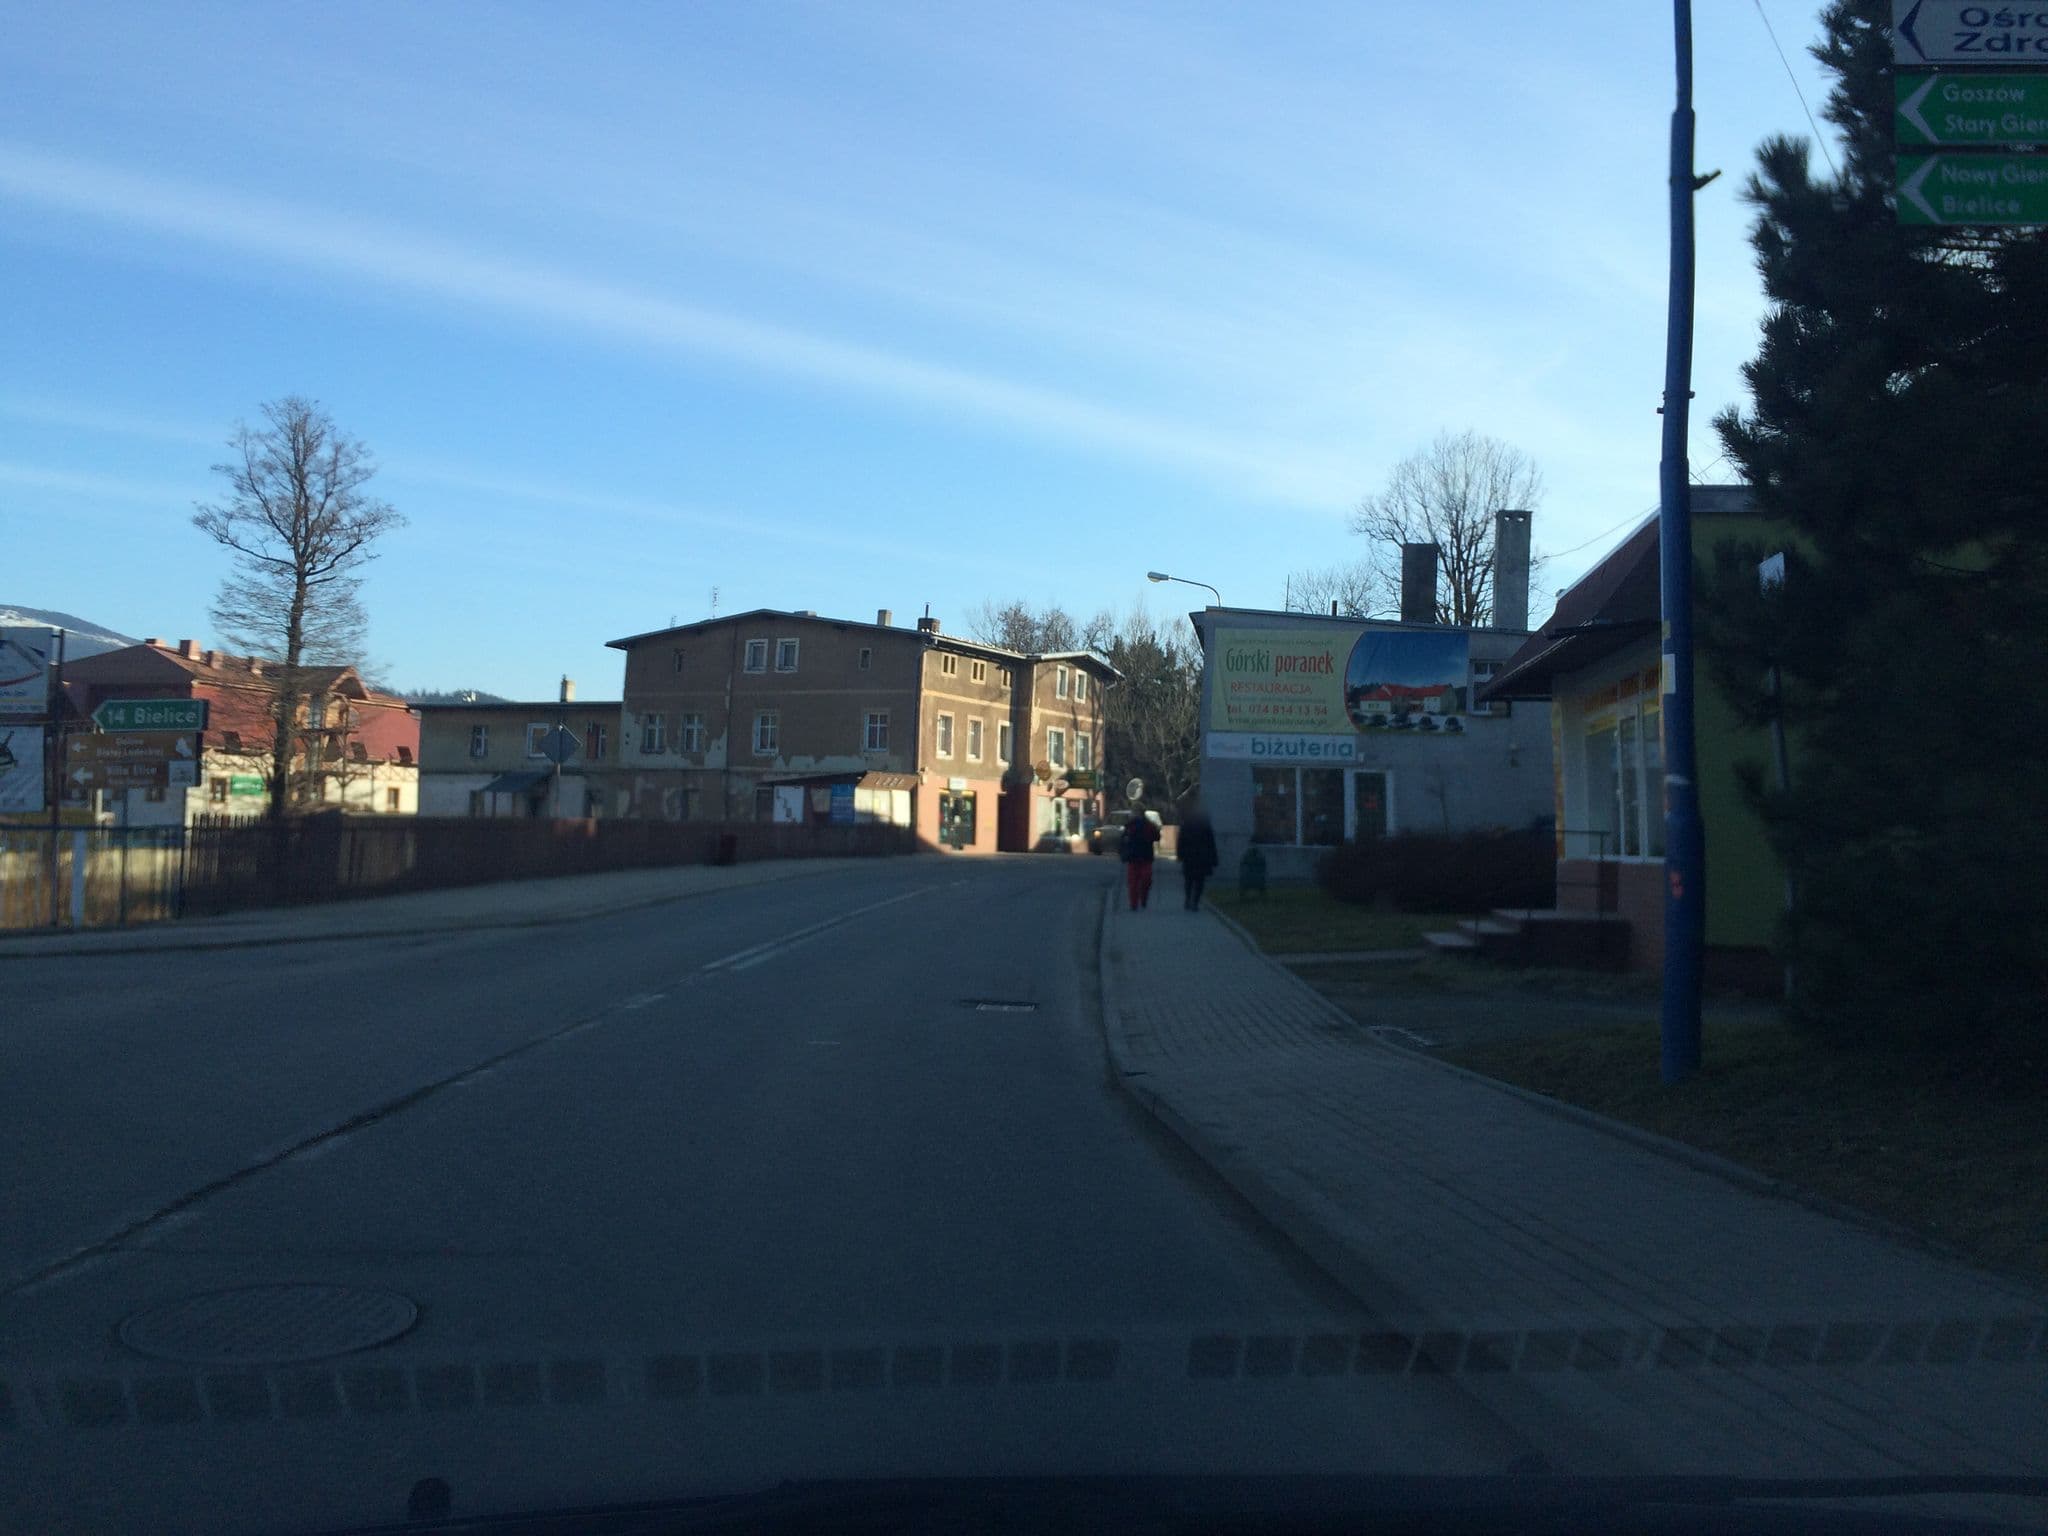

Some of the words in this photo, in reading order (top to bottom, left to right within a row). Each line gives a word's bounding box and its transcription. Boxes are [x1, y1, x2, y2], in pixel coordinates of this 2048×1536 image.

[1944, 113, 1997, 138] Stary
[1941, 164, 1998, 187] Nowy
[1943, 193, 2022, 214] Bielice
[1225, 647, 1271, 673] Górski
[1275, 651, 1334, 676] poranek
[107, 708, 126, 724] 14
[135, 707, 198, 724] Bielice
